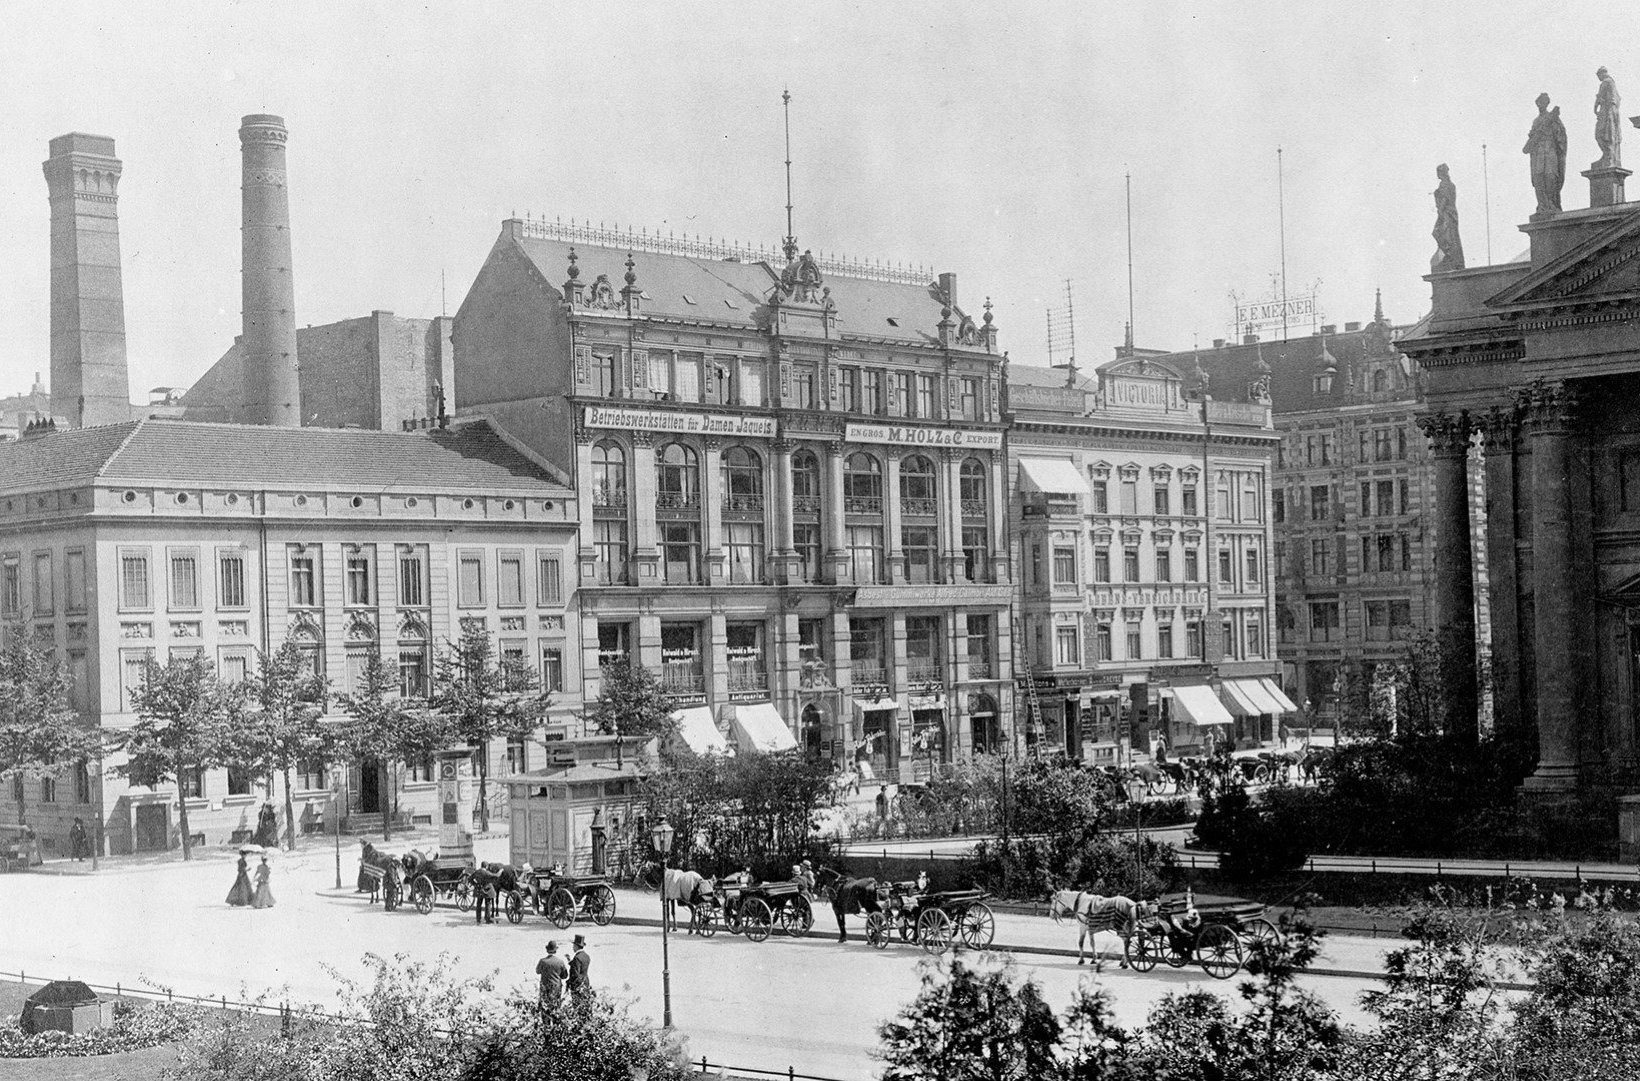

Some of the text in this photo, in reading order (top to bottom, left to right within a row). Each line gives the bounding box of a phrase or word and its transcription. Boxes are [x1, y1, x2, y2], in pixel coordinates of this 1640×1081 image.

[1117, 382, 1166, 405] VICTORIA
[590, 407, 684, 431] Betriebswerkstätten
[687, 416, 699, 430] für
